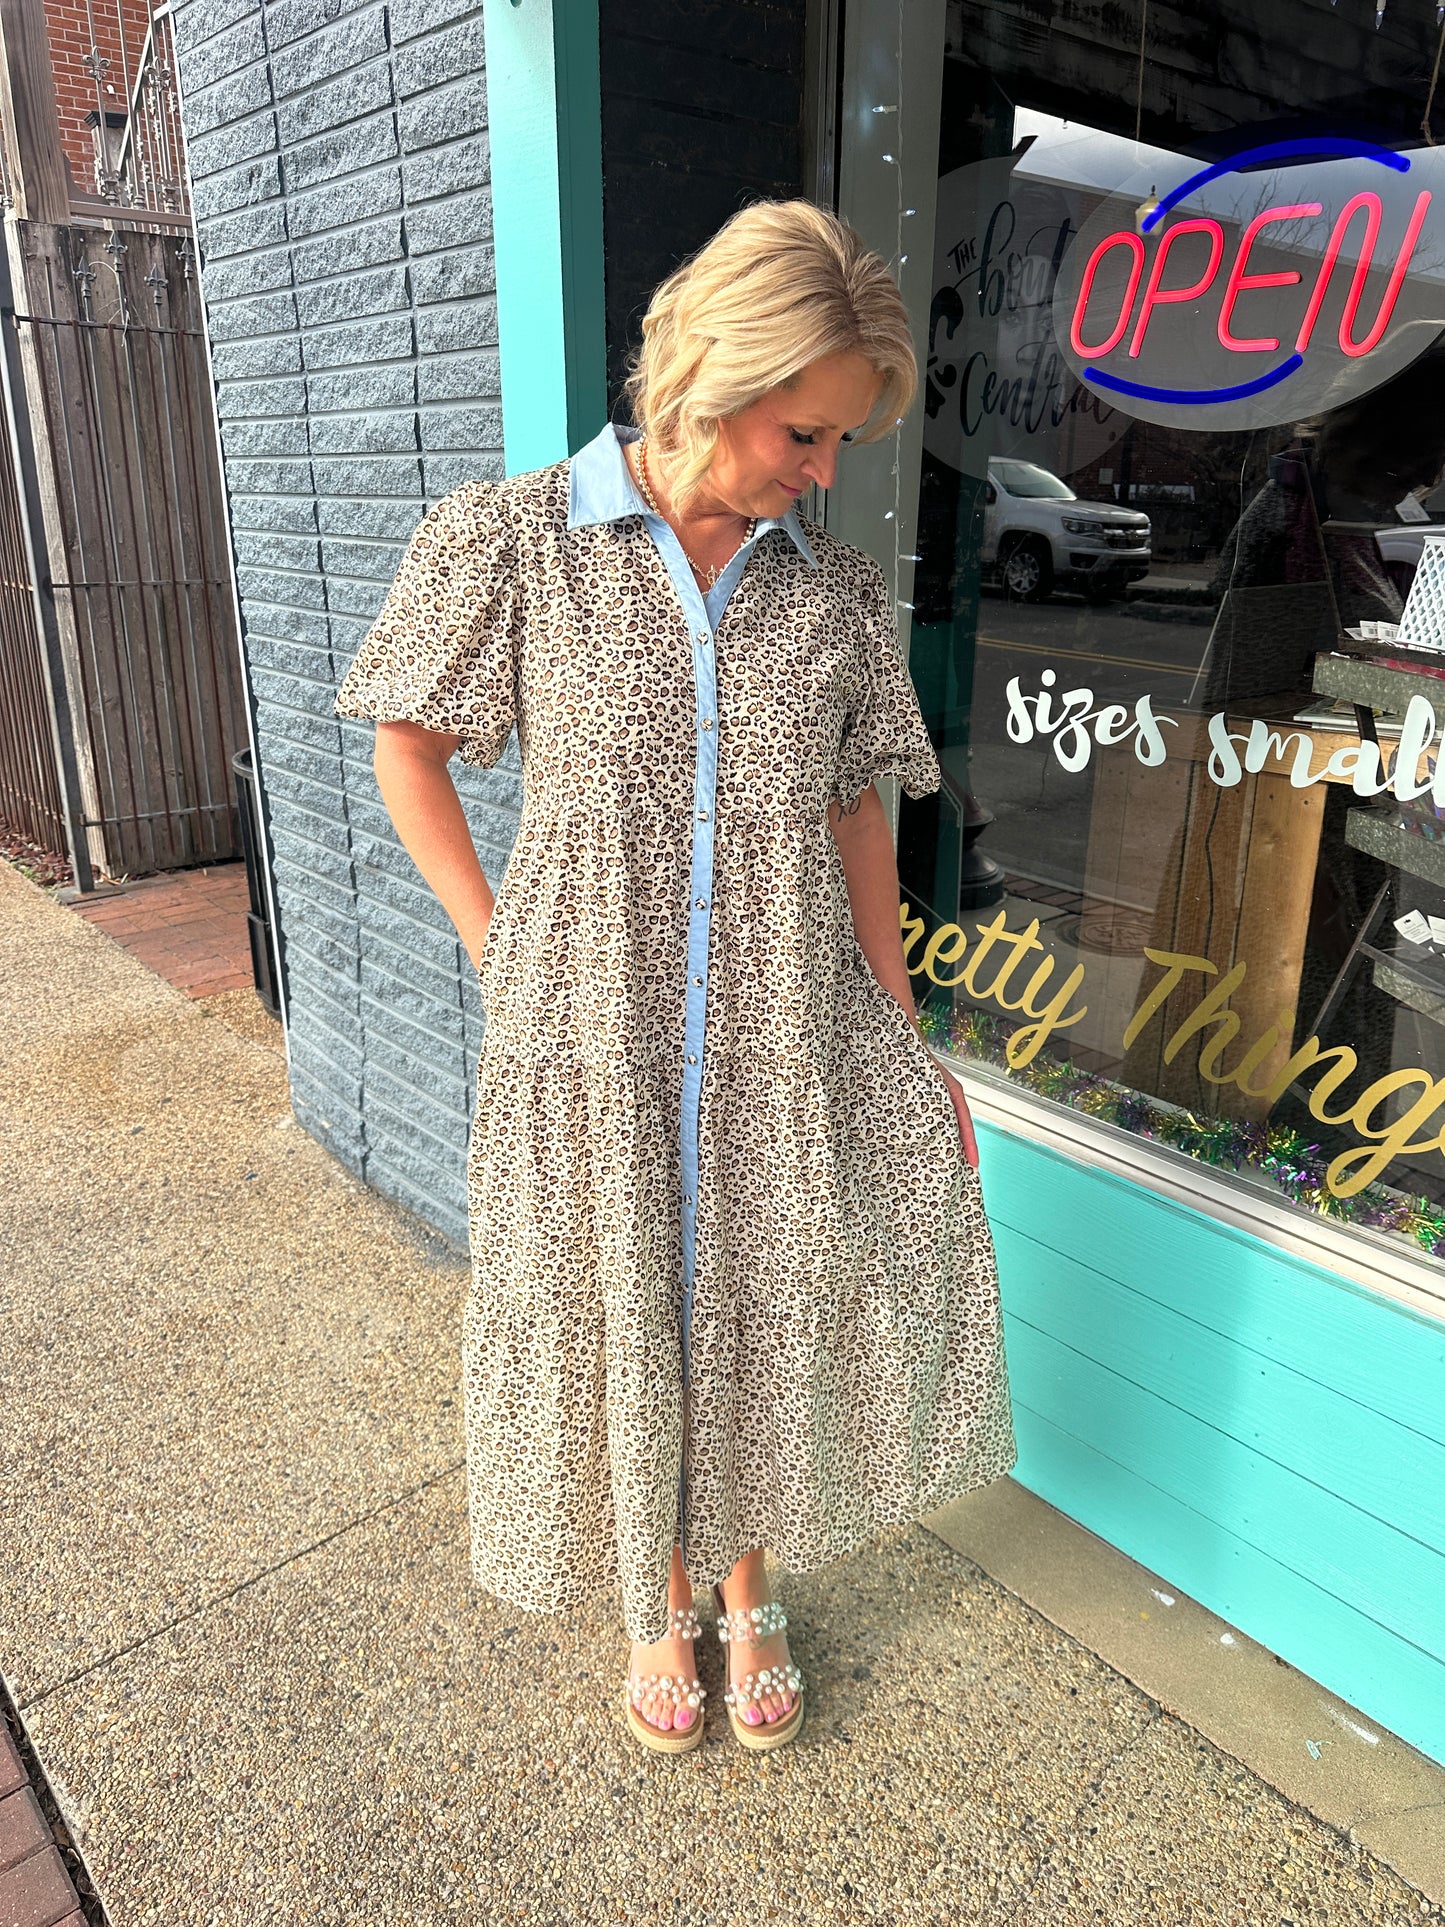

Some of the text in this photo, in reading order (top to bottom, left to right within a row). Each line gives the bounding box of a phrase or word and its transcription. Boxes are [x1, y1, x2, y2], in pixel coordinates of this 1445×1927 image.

[1070, 191, 1432, 359] OPEN
[1005, 669, 1179, 773] sizes
[899, 902, 1445, 1199] retty Thing
